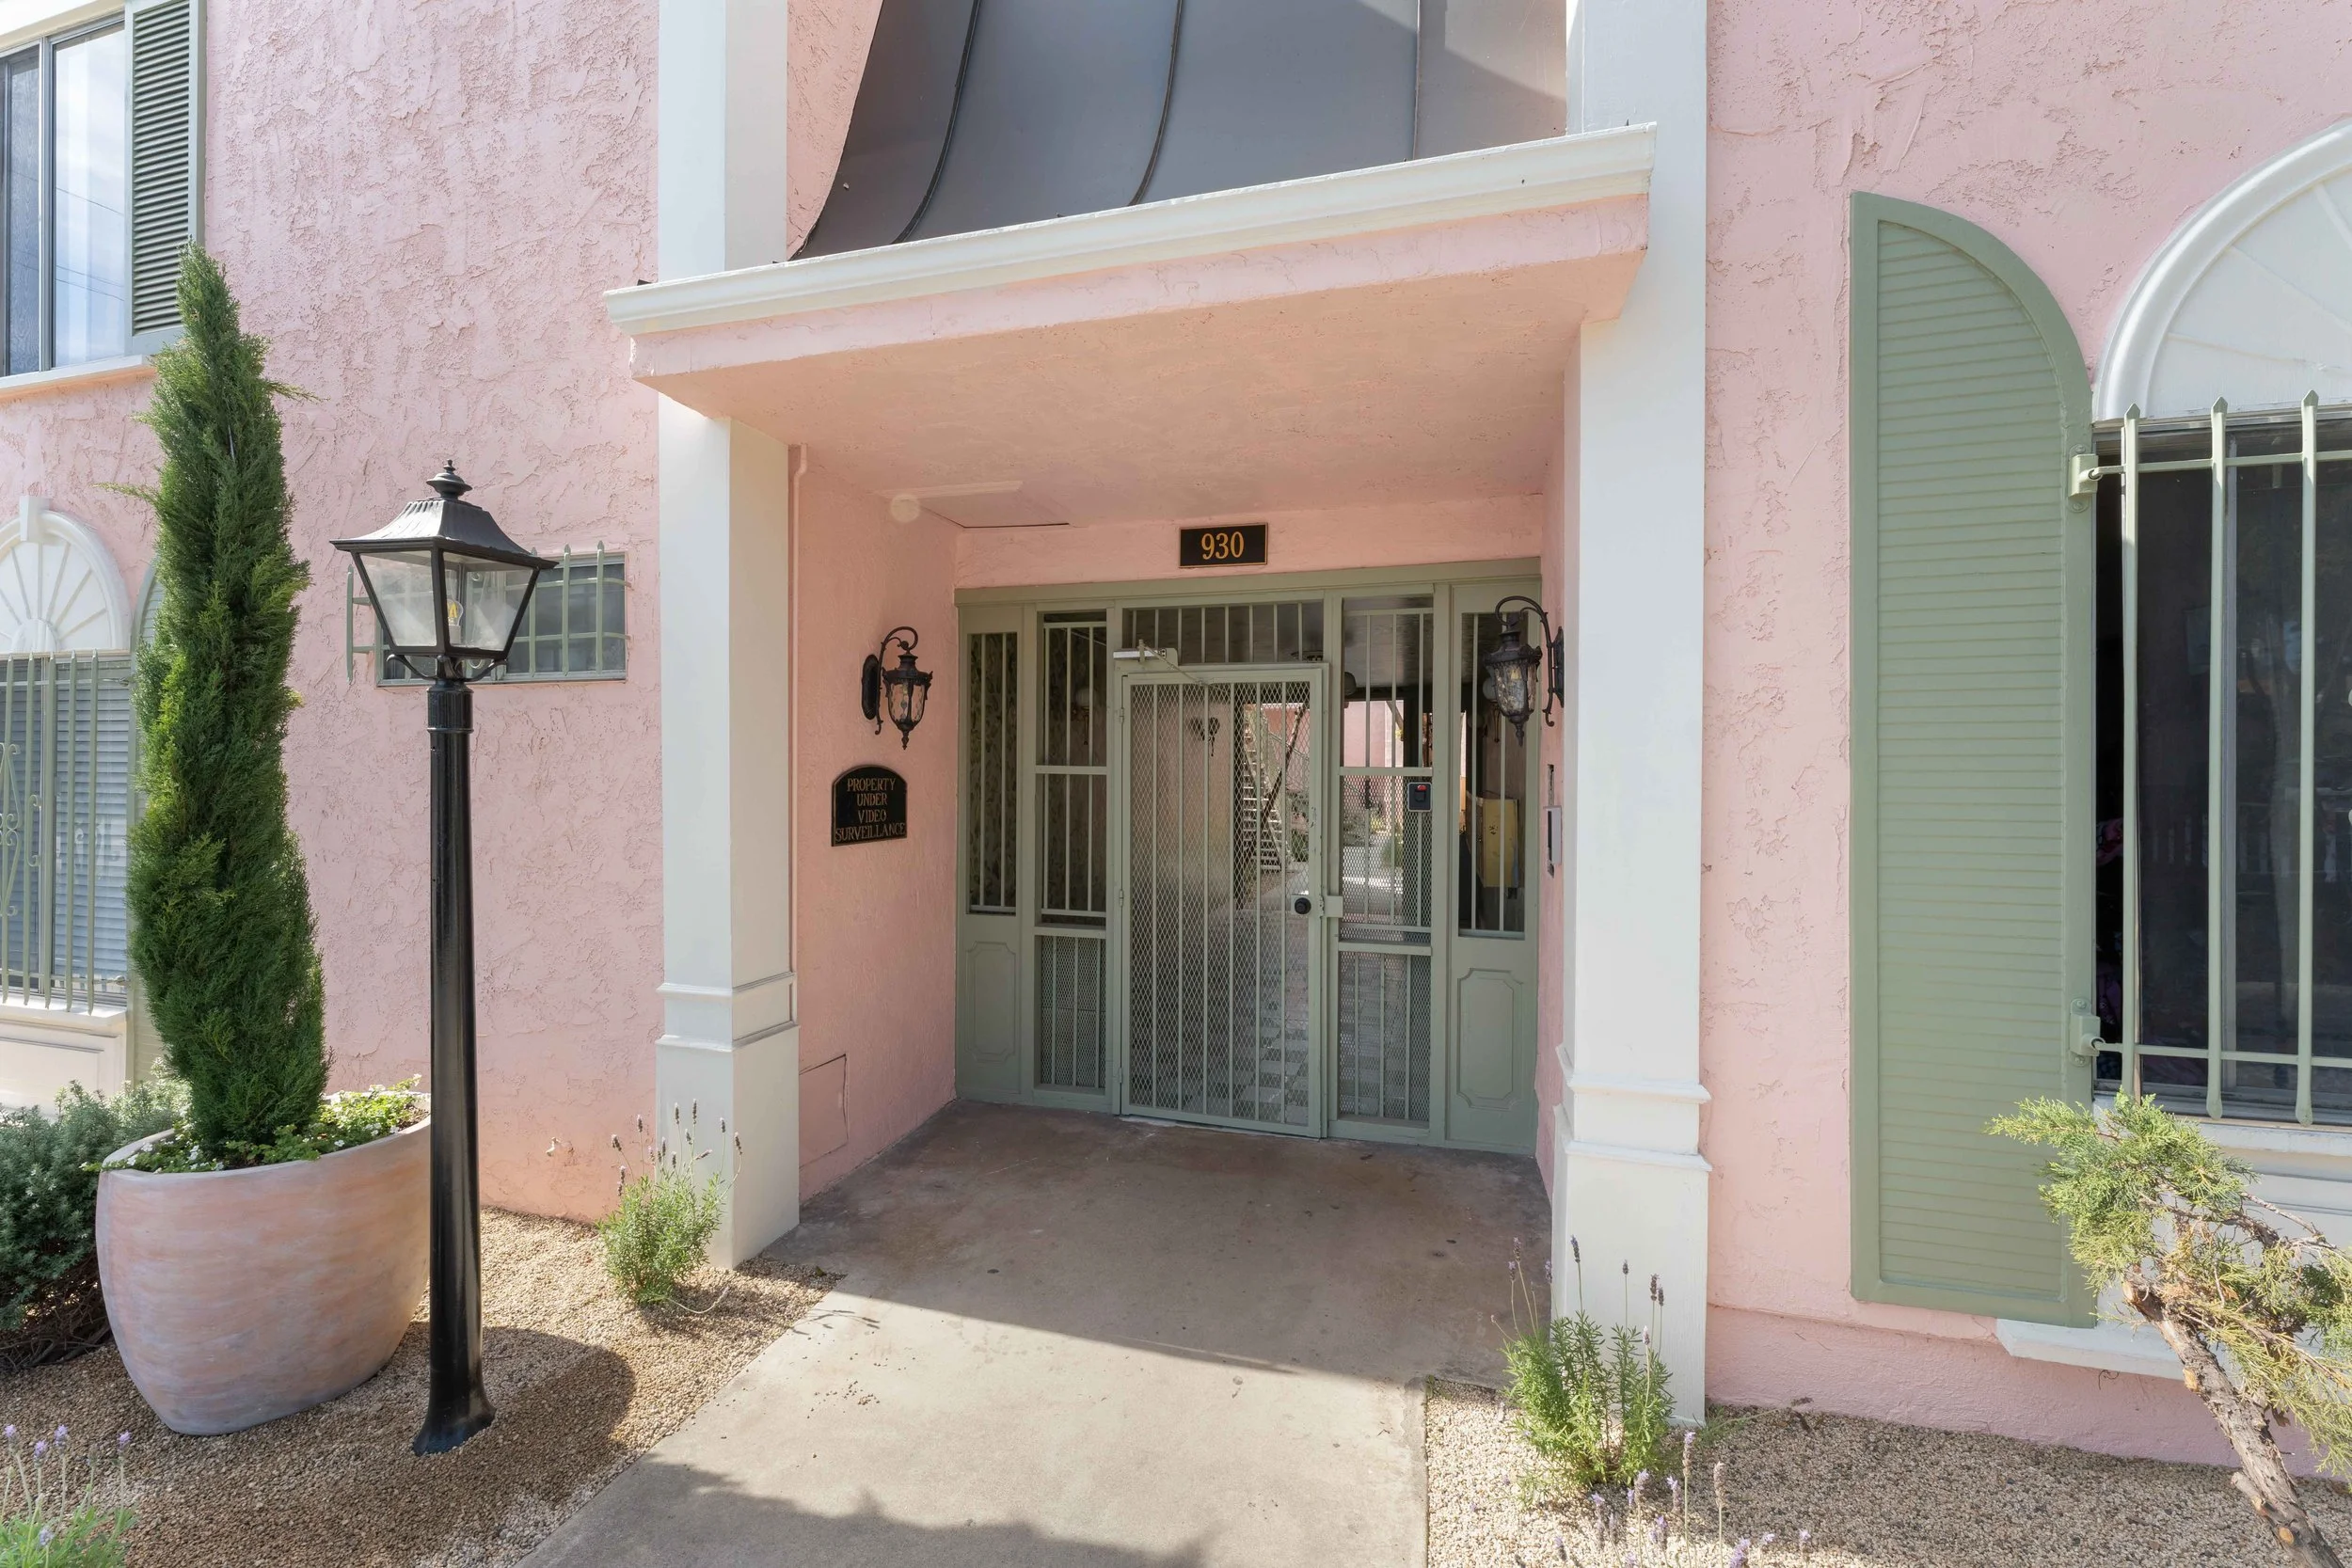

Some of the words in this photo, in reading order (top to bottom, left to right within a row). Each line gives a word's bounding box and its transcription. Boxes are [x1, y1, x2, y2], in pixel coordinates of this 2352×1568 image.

[1201, 531, 1244, 560] 930
[847, 778, 896, 792] PROPERTY
[857, 793, 888, 806] UNDER
[858, 809, 887, 823] VIDEO
[835, 823, 905, 842] SURVEILLANCE
